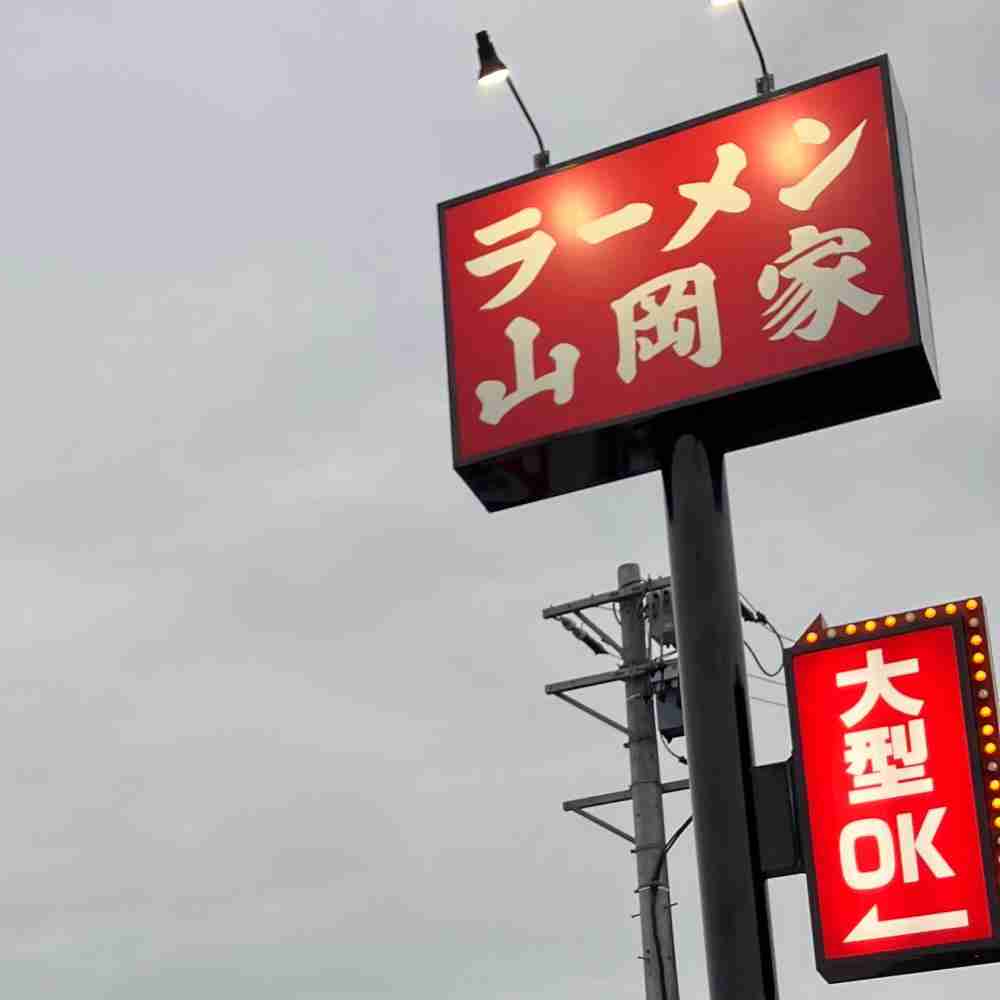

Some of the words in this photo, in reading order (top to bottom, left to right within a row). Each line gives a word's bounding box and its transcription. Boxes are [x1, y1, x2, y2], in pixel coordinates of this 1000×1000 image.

[465, 117, 867, 311] ラーメン
[474, 225, 885, 425] 山岡家
